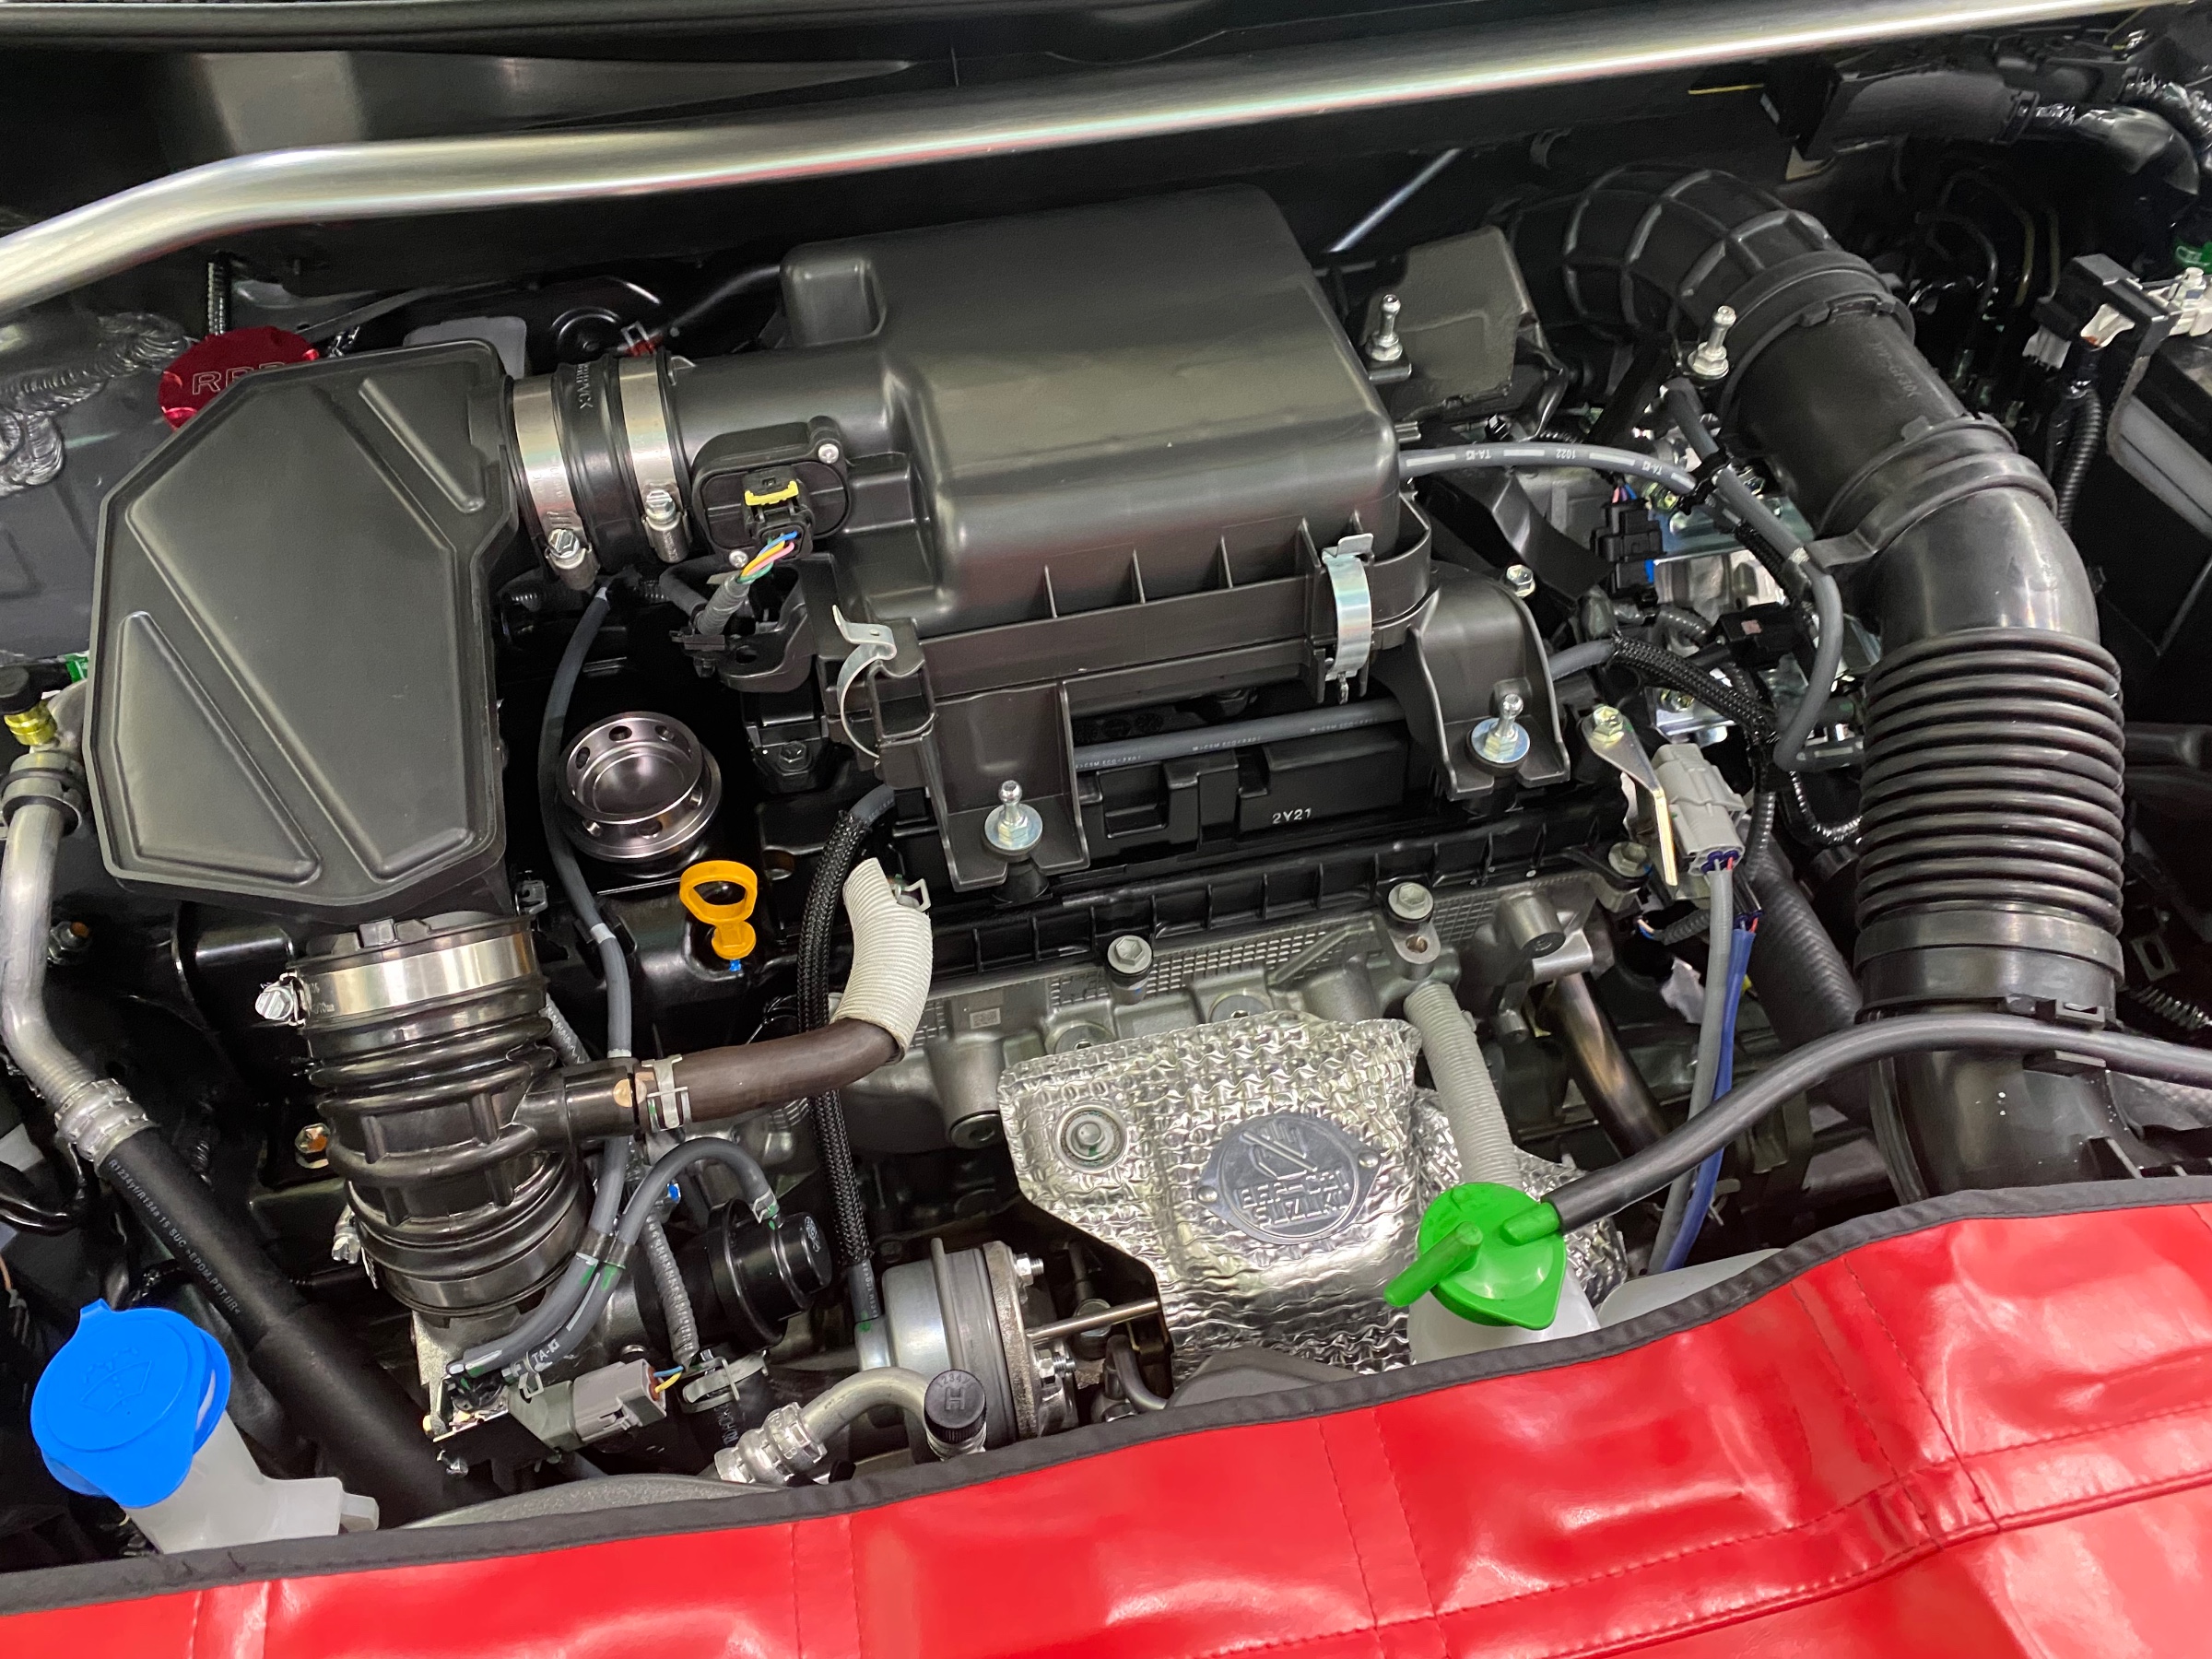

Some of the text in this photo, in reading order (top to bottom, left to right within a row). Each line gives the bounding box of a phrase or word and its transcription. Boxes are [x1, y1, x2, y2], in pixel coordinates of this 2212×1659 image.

[1555, 448, 1576, 460] 1022
[1272, 807, 1312, 825] 2Y21
[108, 1159, 160, 1218] R1234yf/R134a
[169, 1227, 187, 1248] SUC
[945, 1386, 966, 1411] H
